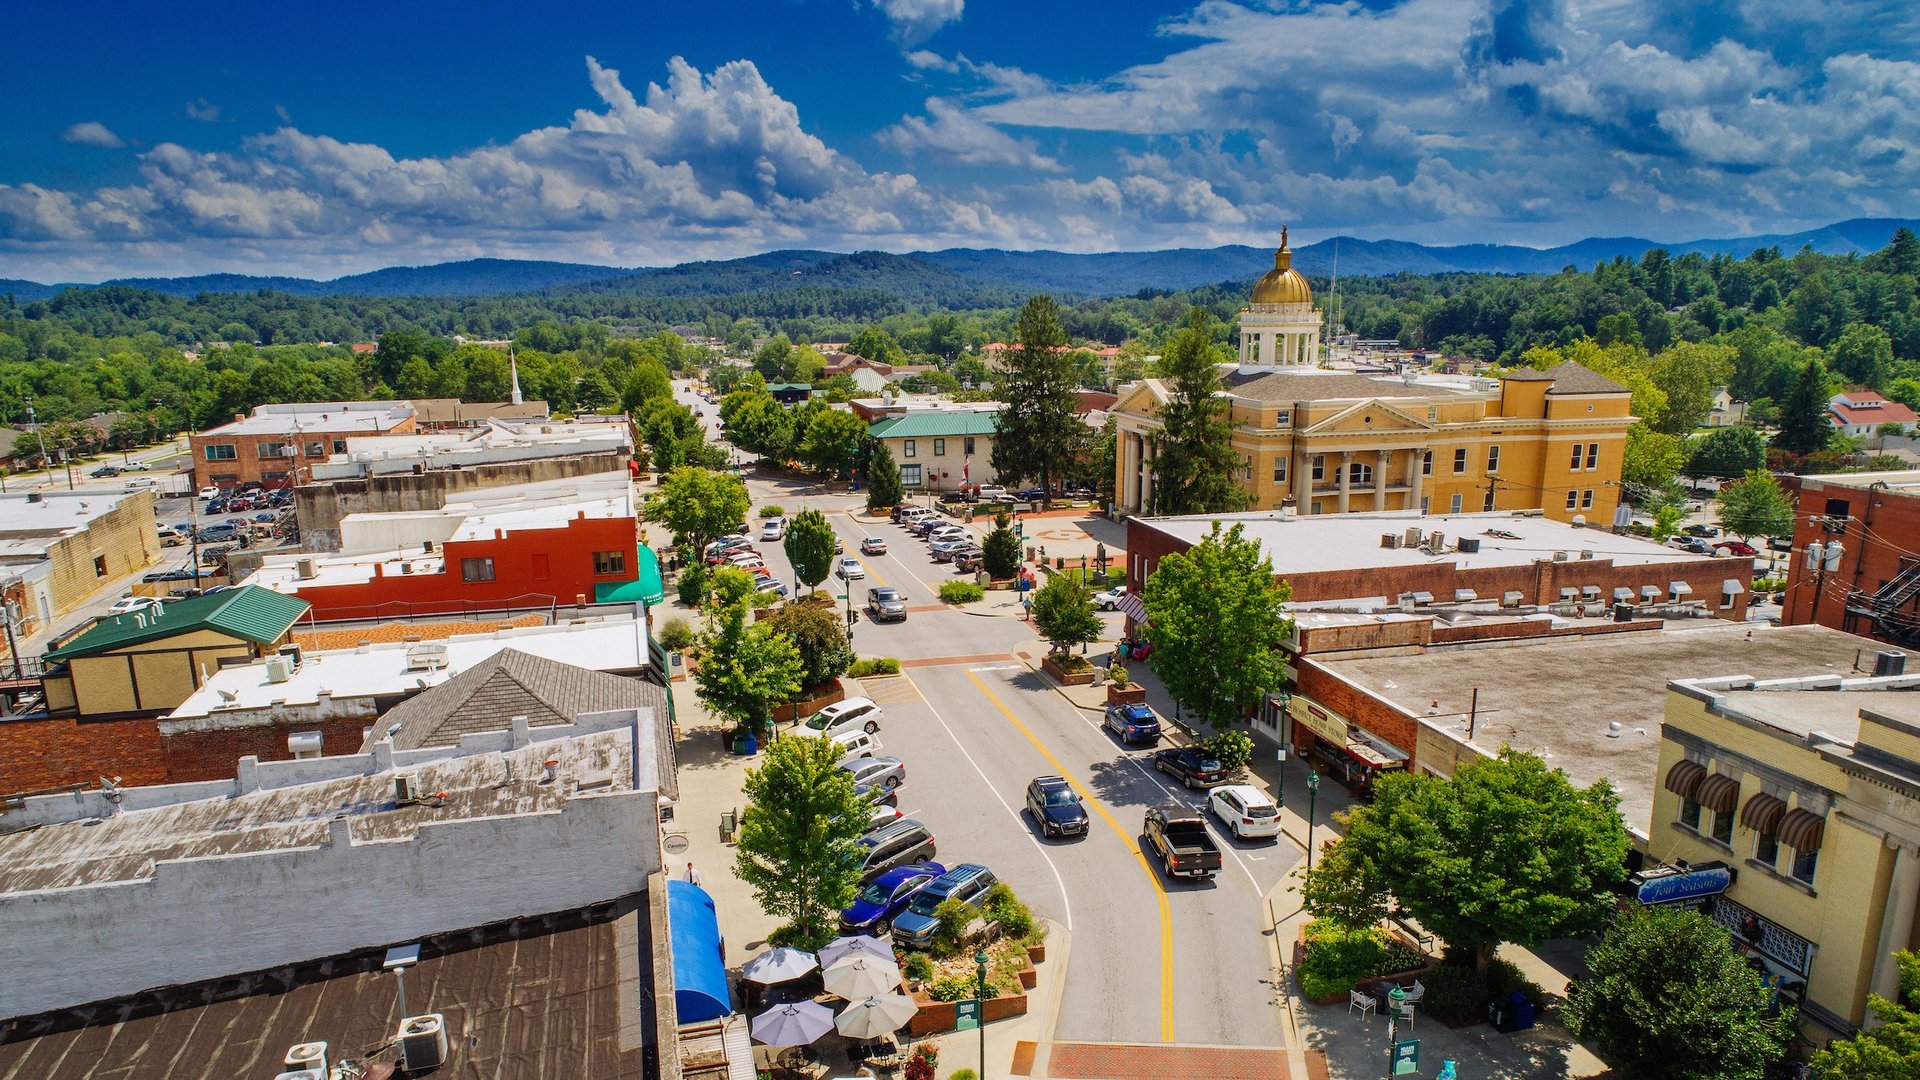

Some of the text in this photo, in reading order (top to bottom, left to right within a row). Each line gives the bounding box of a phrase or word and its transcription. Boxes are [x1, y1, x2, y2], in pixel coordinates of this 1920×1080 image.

[1293, 705, 1312, 721] HOSPICE
[1312, 716, 1327, 730] HOME
[1328, 726, 1343, 741] STORE
[1680, 880, 1717, 892] Seasons
